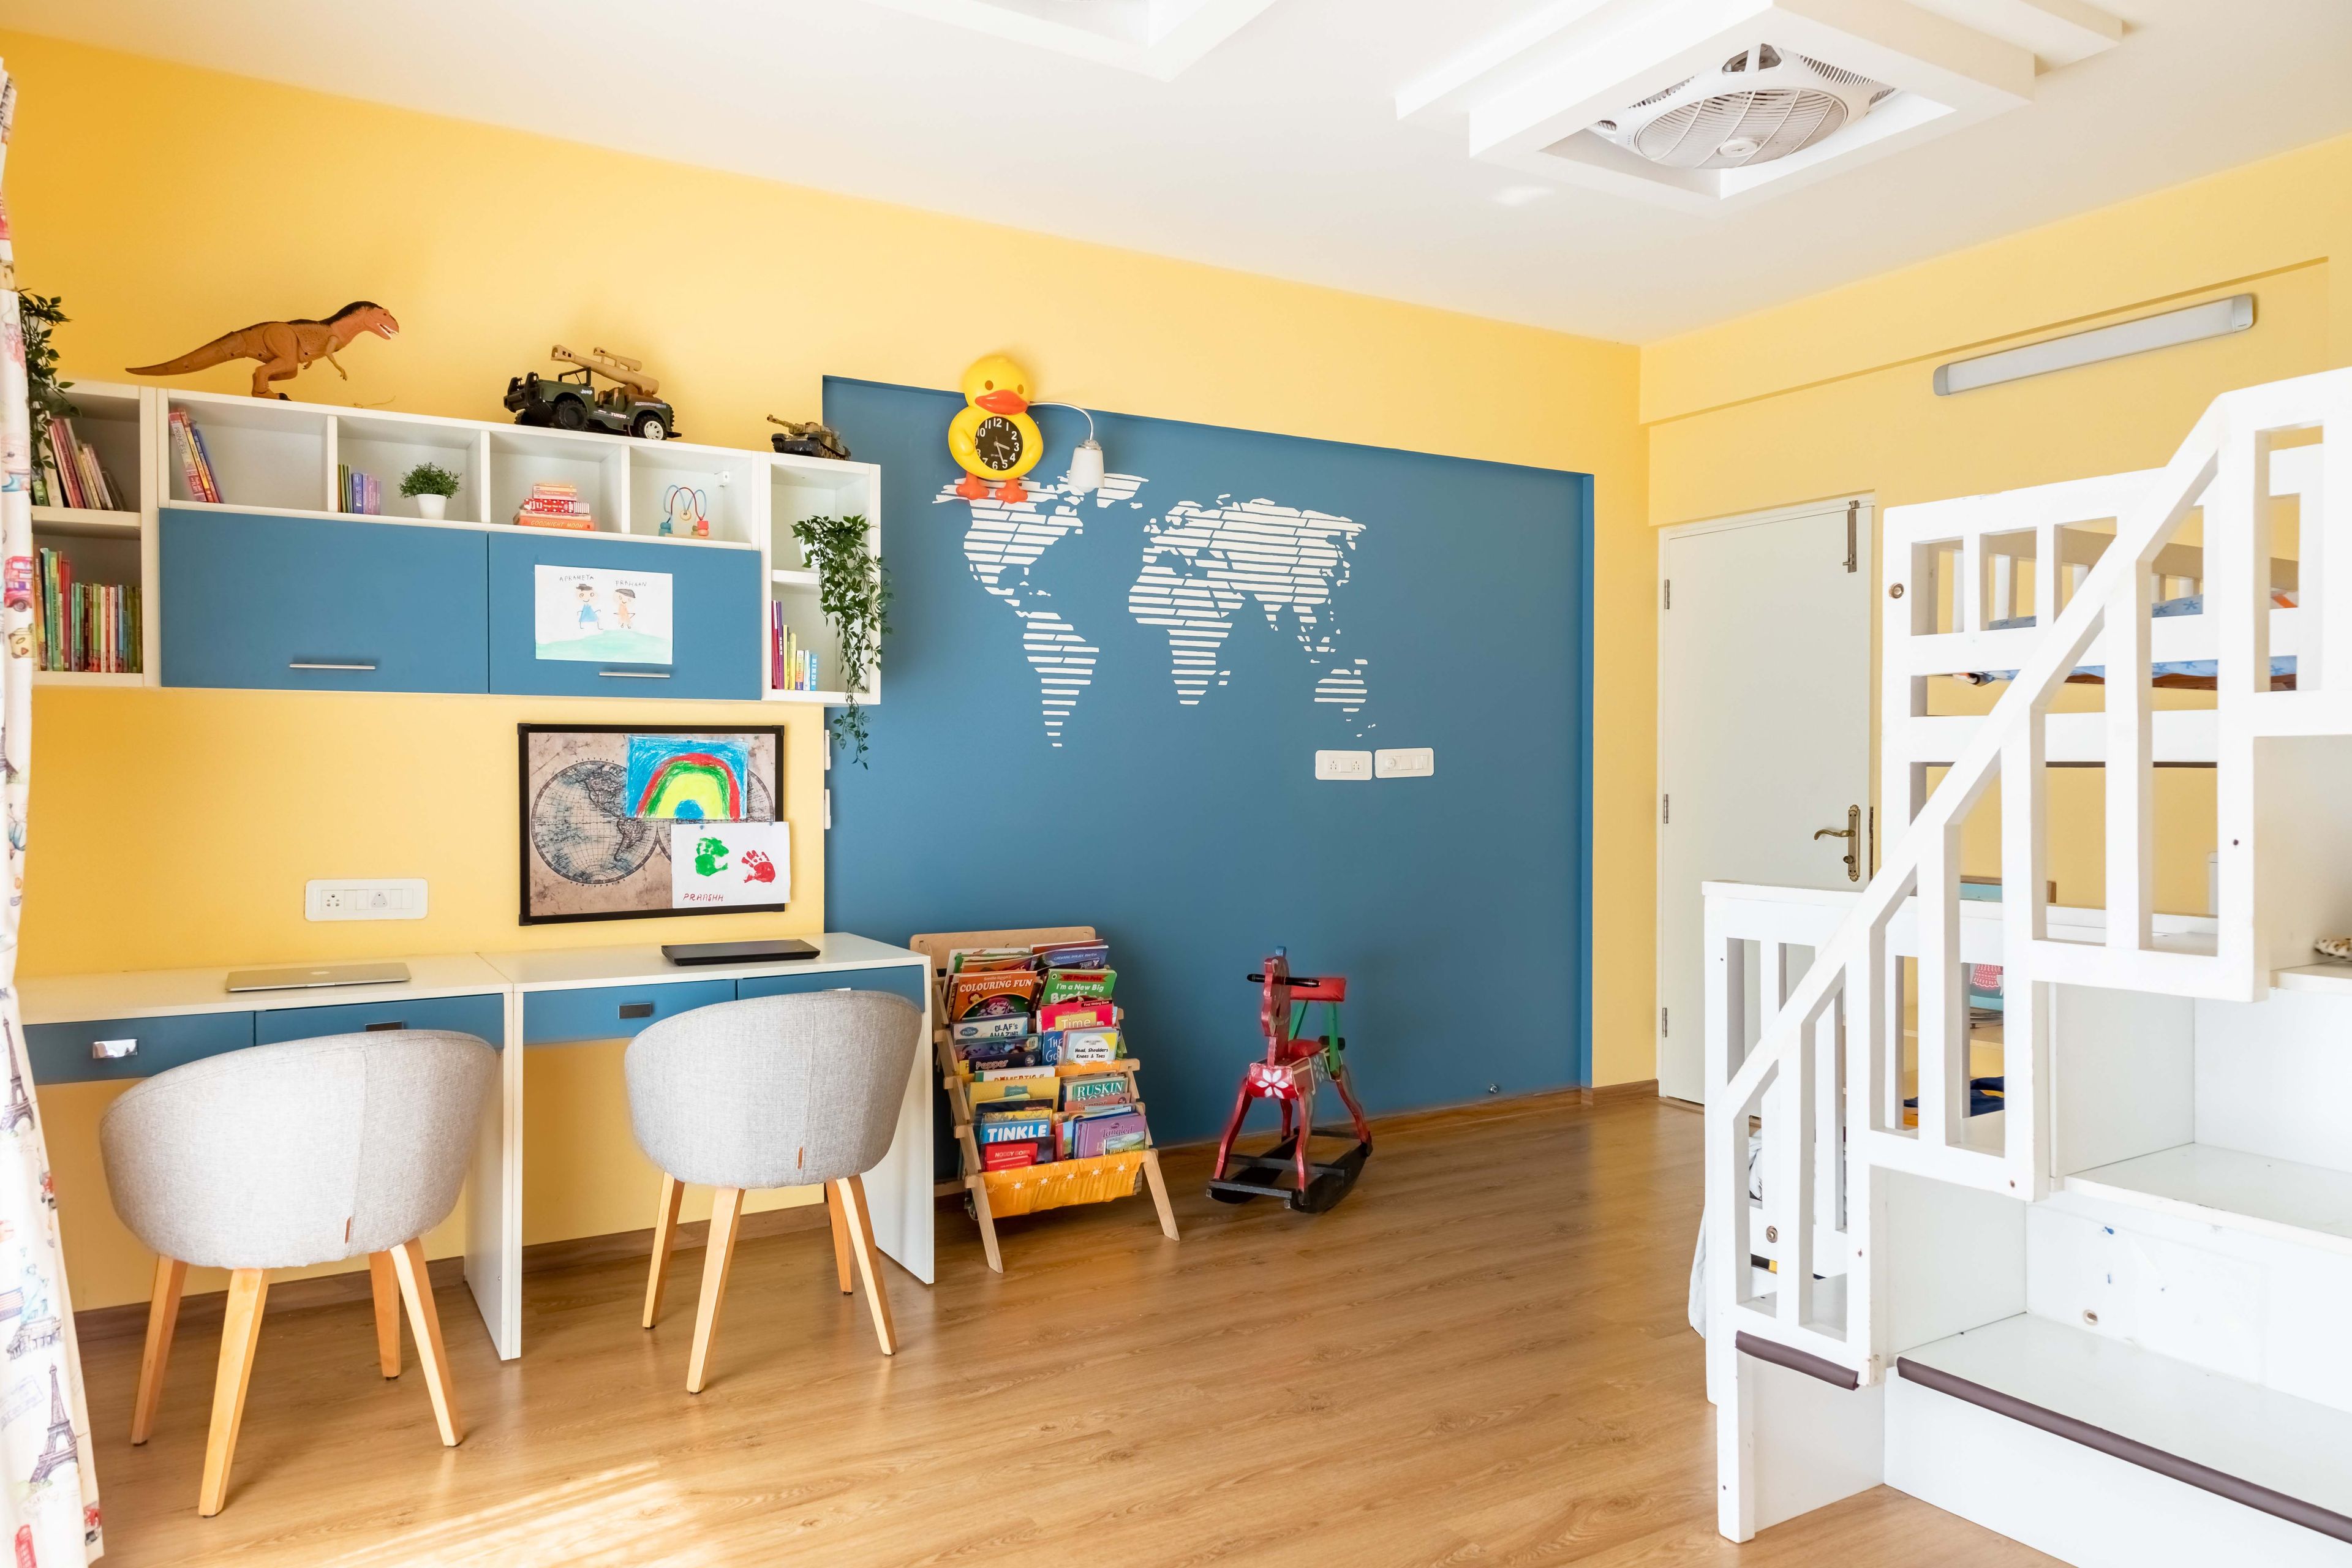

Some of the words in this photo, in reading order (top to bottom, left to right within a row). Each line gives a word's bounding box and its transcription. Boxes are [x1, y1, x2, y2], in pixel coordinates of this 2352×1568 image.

[985, 420, 991, 429] 11
[993, 417, 1002, 428] 12
[1006, 422, 1009, 431] 1
[977, 428, 986, 437] 10
[1011, 431, 1017, 440] 2
[174, 427, 187, 454] PRINCESS
[1014, 442, 1019, 451] 3
[1009, 453, 1016, 462] 4
[992, 461, 998, 470] 6
[1002, 459, 1008, 469] 5
[960, 980, 1012, 992] COLOURING
[1013, 979, 1033, 987] FUN
[1061, 1018, 1091, 1030] Time
[976, 1059, 1009, 1070] Pepper
[1077, 1082, 1123, 1097] RUSKIN
[987, 1125, 1047, 1142] TINKLE
